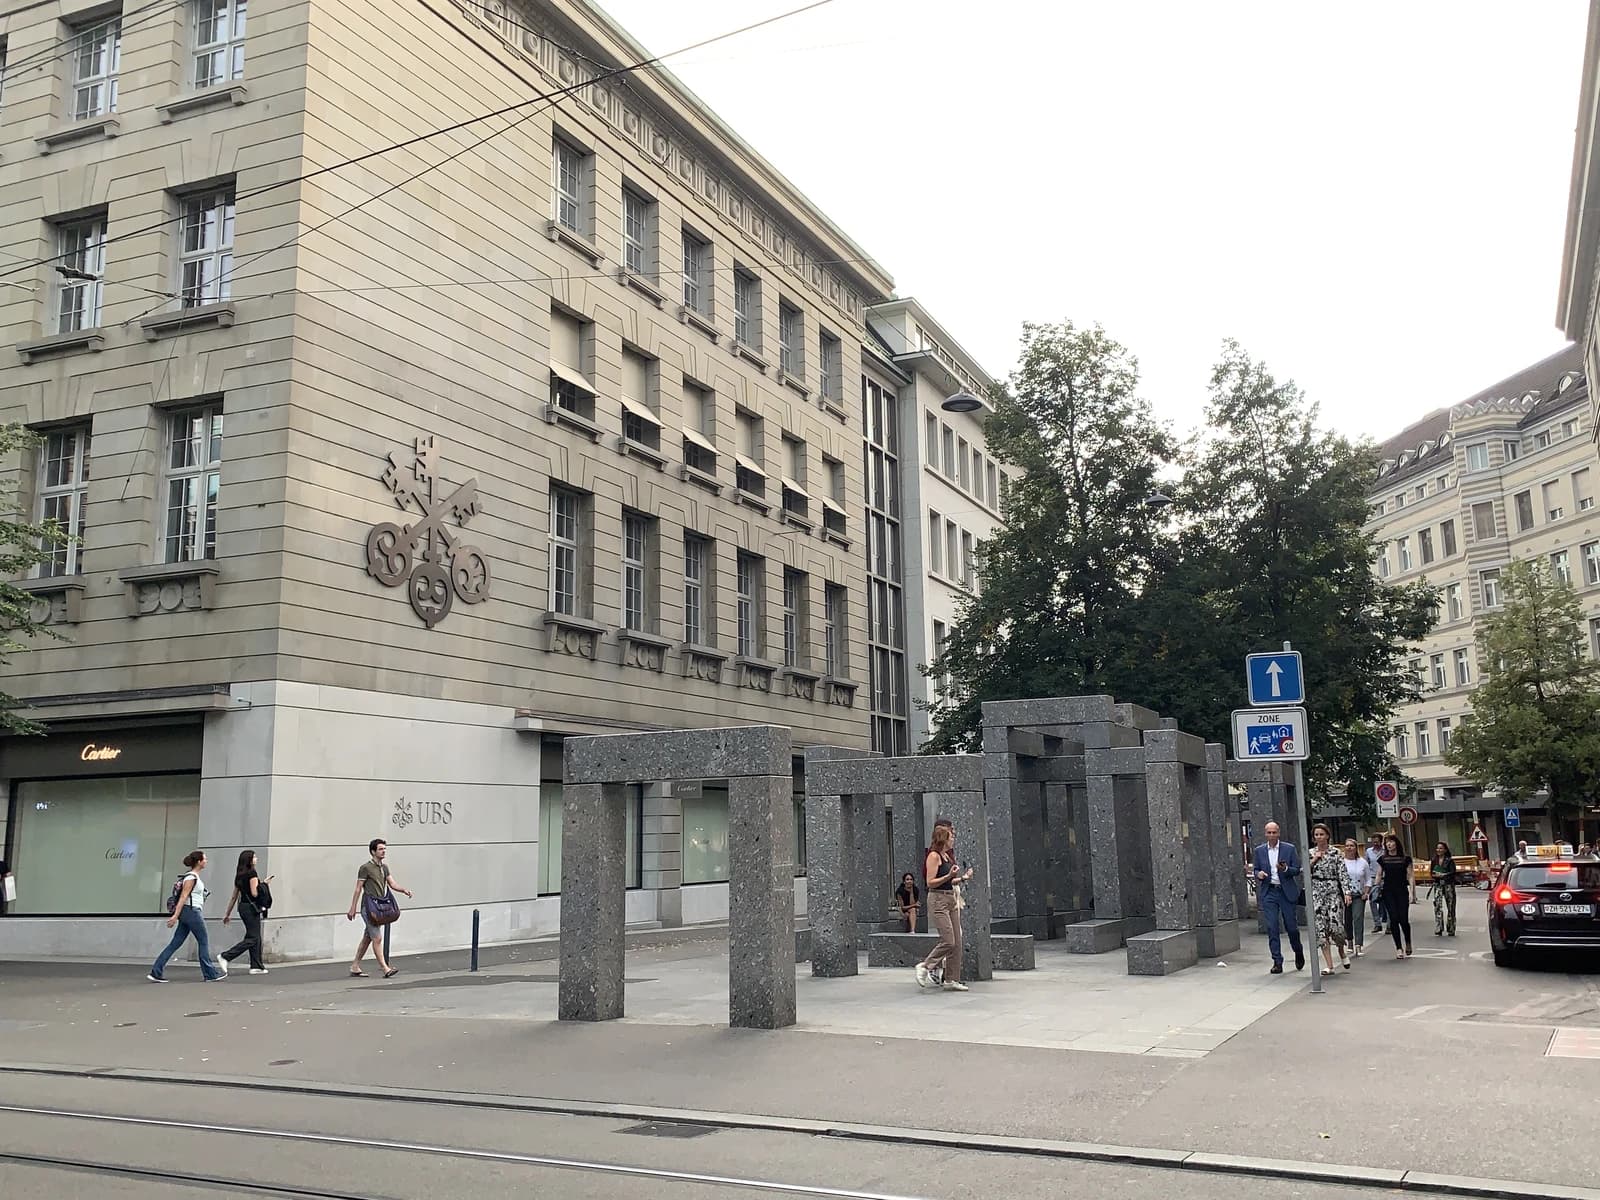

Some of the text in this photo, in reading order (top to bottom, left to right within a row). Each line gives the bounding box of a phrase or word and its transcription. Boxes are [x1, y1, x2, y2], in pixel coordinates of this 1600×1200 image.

[1257, 714, 1281, 723] ZONE
[81, 744, 121, 760] Cartier
[1284, 742, 1294, 751] 20
[416, 801, 453, 825] UBS
[104, 848, 135, 860] Cartier
